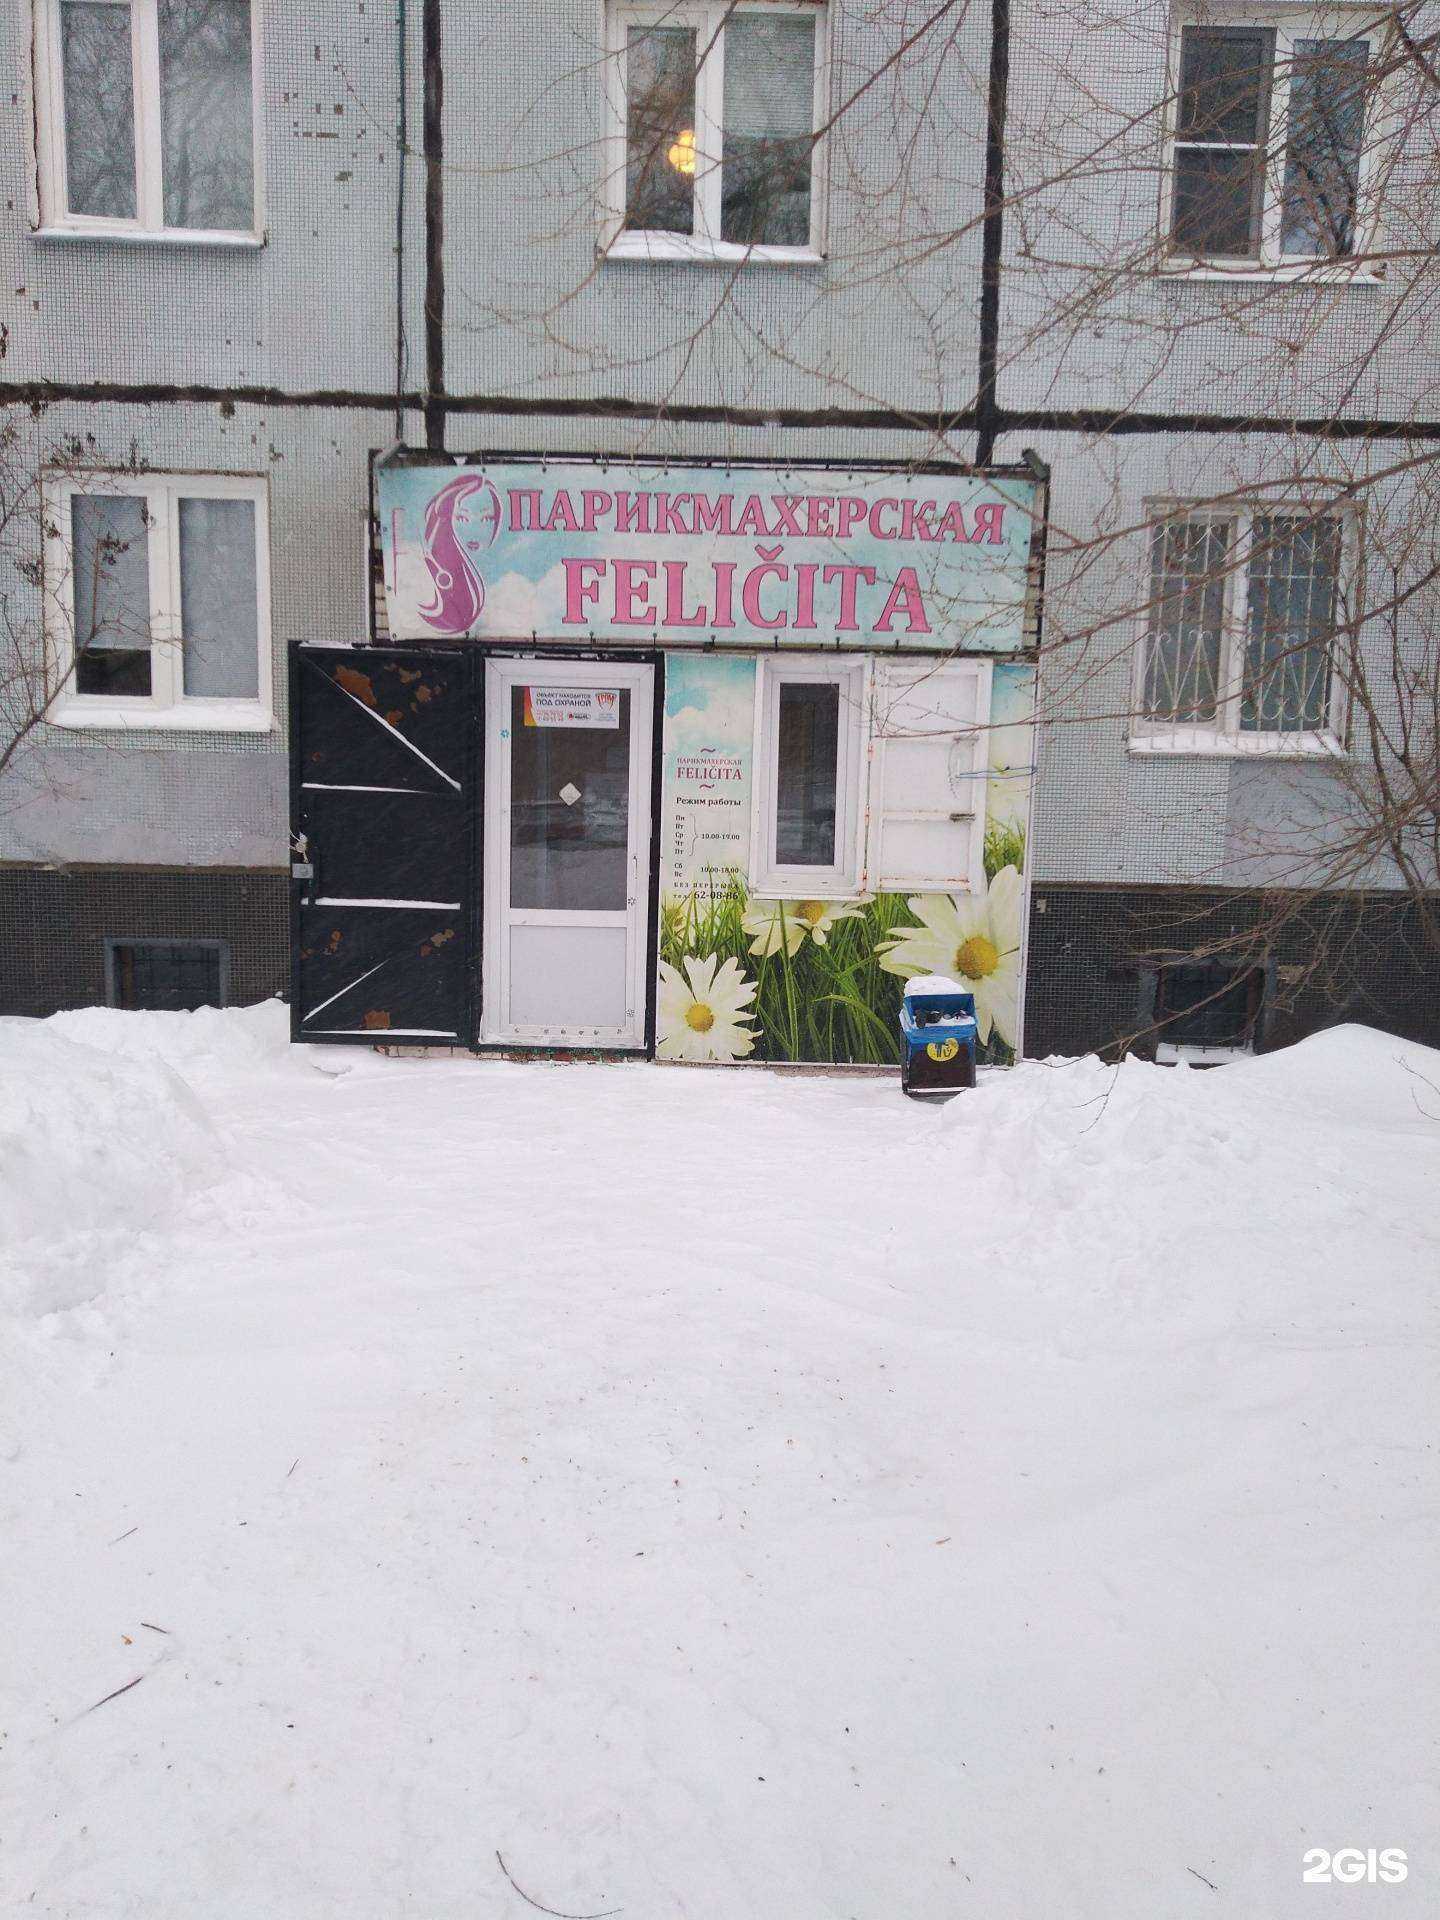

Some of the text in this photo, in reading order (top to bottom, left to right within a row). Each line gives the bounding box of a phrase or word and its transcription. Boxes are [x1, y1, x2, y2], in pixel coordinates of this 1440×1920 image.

[507, 488, 1006, 545] ПАРИКМАХЕРСКАЯ
[561, 544, 932, 633] FELIČITA
[555, 699, 591, 707] ОХРАНОЙ
[677, 758, 742, 766] ПАРИКМАХЕРСКАЯ
[676, 797, 742, 807] Режим работы
